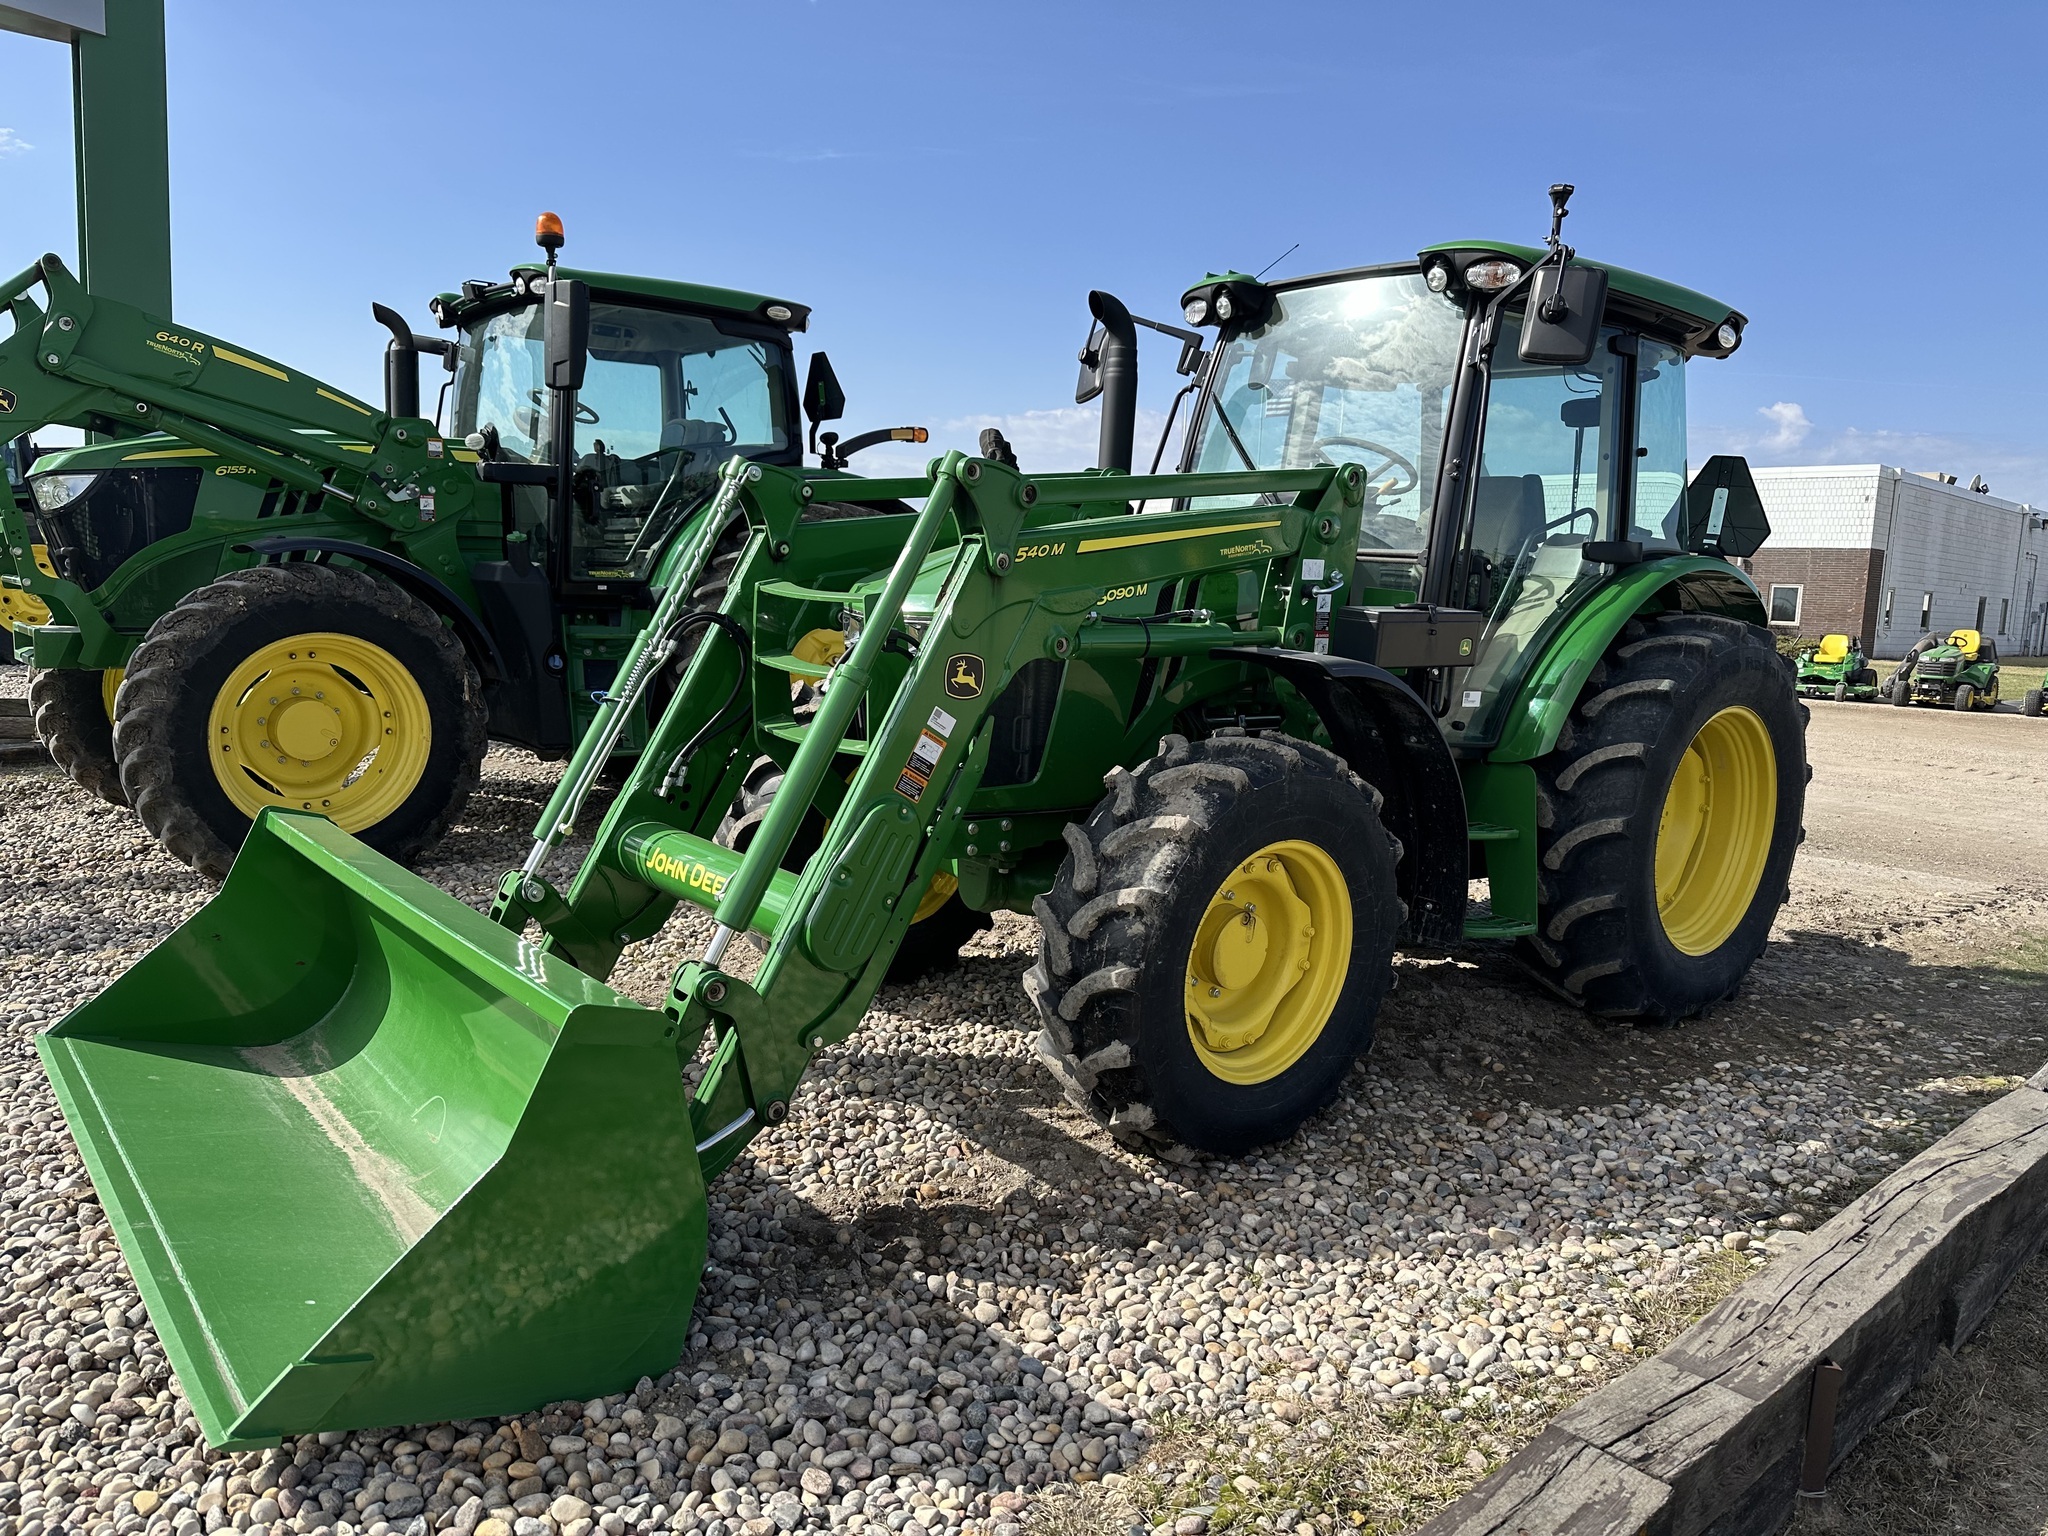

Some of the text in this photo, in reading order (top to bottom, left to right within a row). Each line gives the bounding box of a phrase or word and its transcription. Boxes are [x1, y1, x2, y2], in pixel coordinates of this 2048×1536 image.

[155, 331, 191, 347] 640
[191, 341, 205, 353] R
[215, 465, 247, 476] 6155
[1014, 542, 1066, 563] 540 M
[1220, 543, 1257, 556] TRUENORTH
[1136, 582, 1148, 596] M
[645, 847, 729, 896] JOHN DEE
